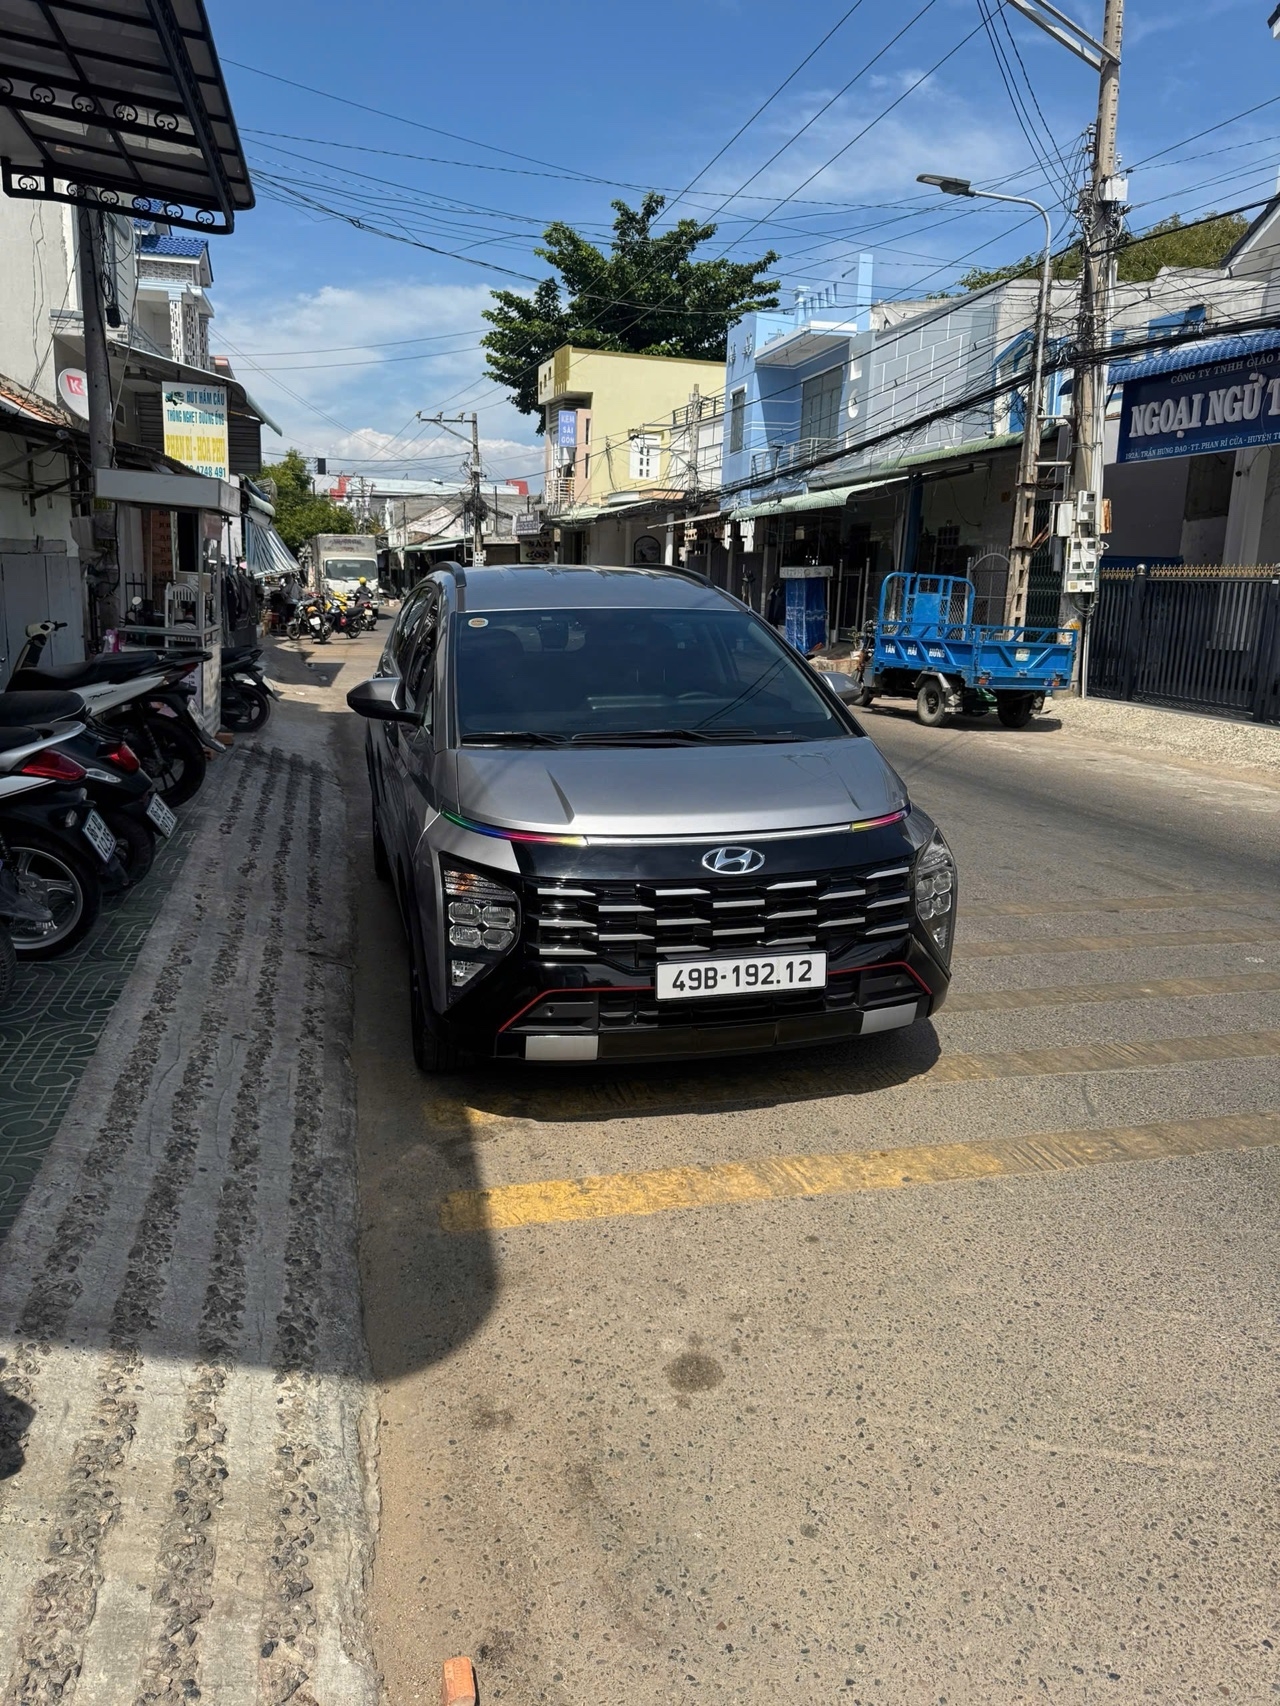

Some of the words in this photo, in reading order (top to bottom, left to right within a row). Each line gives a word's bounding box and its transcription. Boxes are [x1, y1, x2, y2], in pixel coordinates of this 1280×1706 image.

[1171, 373, 1195, 384] CÔNG
[1198, 368, 1211, 378] TY
[1214, 361, 1243, 375] TNHH
[187, 388, 197, 404] HÚT
[1129, 393, 1204, 438] NGOẠI
[1206, 373, 1266, 425] NGỮ
[167, 407, 181, 423] THÔNG
[1201, 440, 1219, 450] PHAN
[214, 467, 226, 478] 491
[672, 960, 812, 991] 49B-192.12
